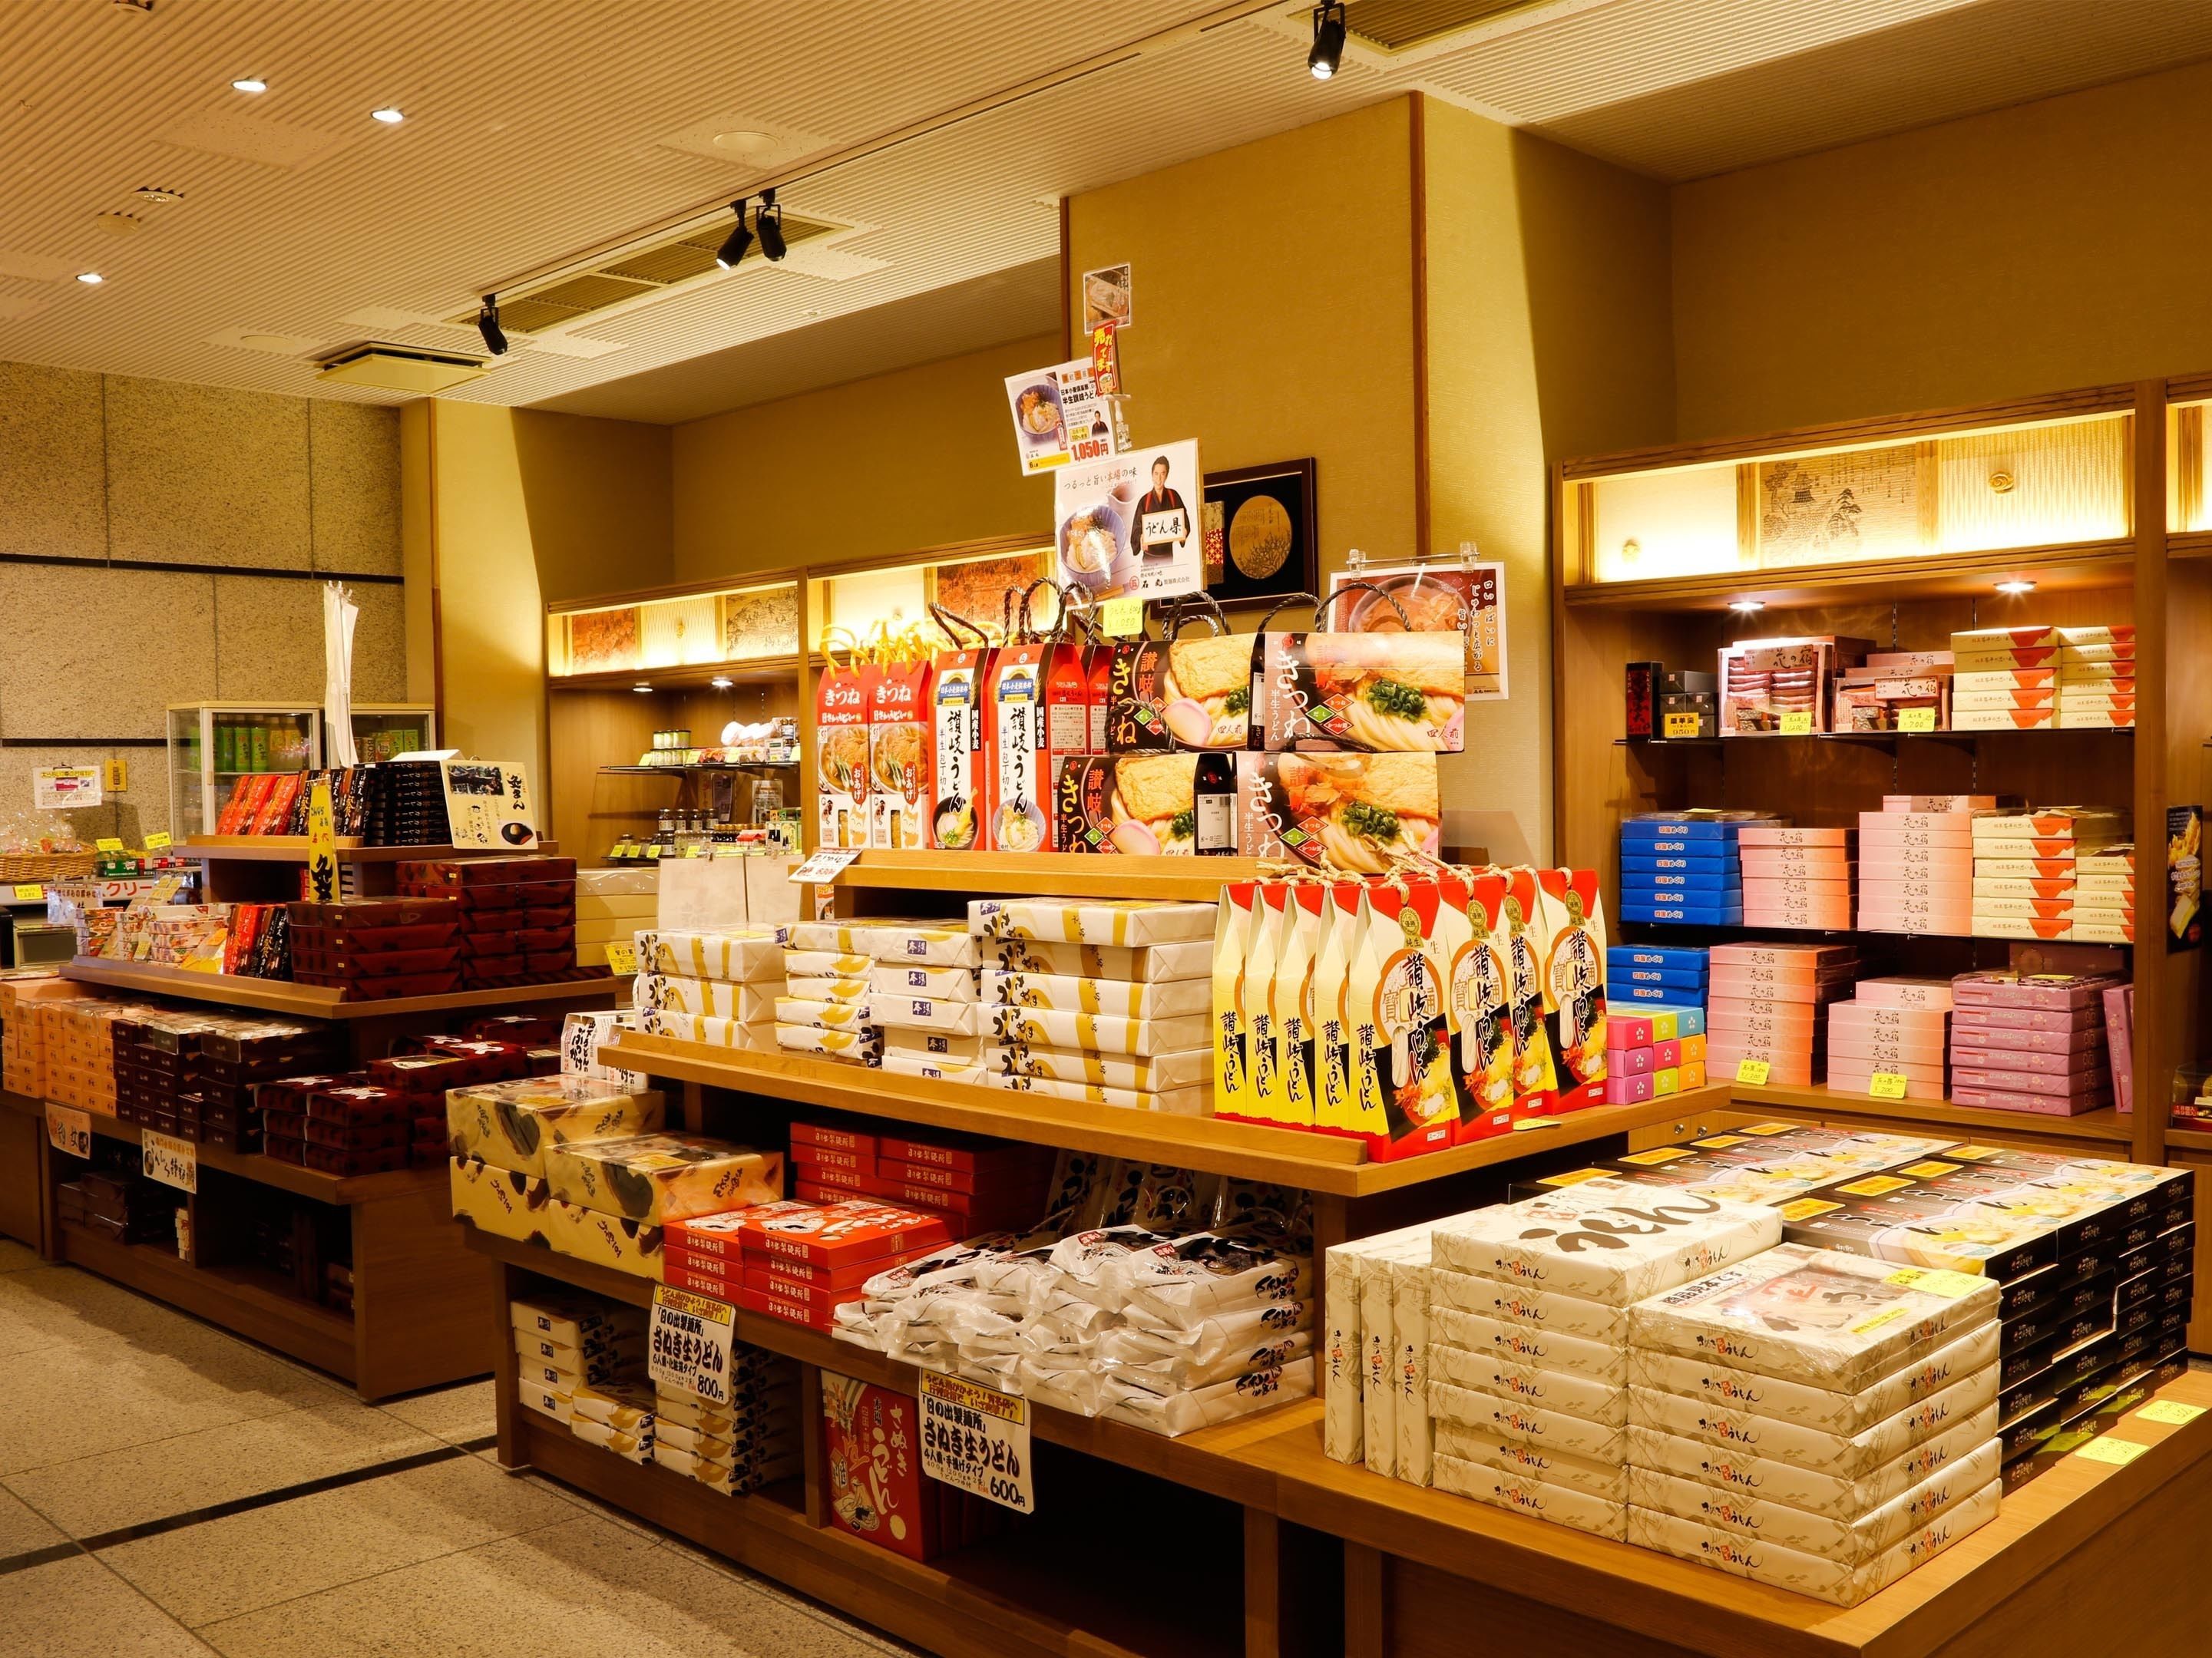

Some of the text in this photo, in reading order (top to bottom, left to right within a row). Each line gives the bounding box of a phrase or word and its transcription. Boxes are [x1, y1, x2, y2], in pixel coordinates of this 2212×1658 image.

[1071, 439, 1108, 461] 1,050円
[1064, 467, 1138, 490] つるっと旨い本場の味
[1146, 517, 1182, 538] うどん県
[1471, 584, 1483, 672] じゅわっと広がる
[1483, 580, 1495, 646] 口いっぱいに
[825, 689, 860, 707] きつね
[876, 685, 911, 705] きつね
[1139, 651, 1158, 695] 讃岐
[1217, 725, 1242, 735] 四人前
[1271, 689, 1281, 741] 半生うどん
[1427, 727, 1460, 738] 四人前
[367, 738, 375, 763] BOSS
[947, 708, 967, 814] 讃岐うどん
[1010, 706, 1030, 814] 讃岐うどん
[853, 768, 861, 801] おあげ
[1086, 769, 1104, 814] 讃岐
[1470, 943, 1496, 1072] 讃岐うどん
[1511, 936, 1531, 1058] 讃岐うどん
[1572, 930, 1591, 1050] 讃岐うどん
[1401, 953, 1431, 1087] 讃岐うどん
[1220, 1010, 1240, 1094] 讃岐うどん
[1252, 1014, 1273, 1098] 讃岐うどん
[1284, 1017, 1304, 1103] 讃岐うどん
[1321, 1019, 1343, 1107] 讃岐うどん
[1356, 1023, 1377, 1111] 讃岐うどん
[1661, 1270, 1744, 1306] 商品見本です
[653, 1326, 723, 1373] さぬき生うどん
[697, 1374, 724, 1401] 800円
[923, 1394, 987, 1433] 「日の出製麺所」
[889, 1403, 908, 1478] さぬき
[924, 1417, 1020, 1478] さぬき生うどん
[868, 1427, 899, 1515] うどん
[990, 1476, 1026, 1507] 600円
